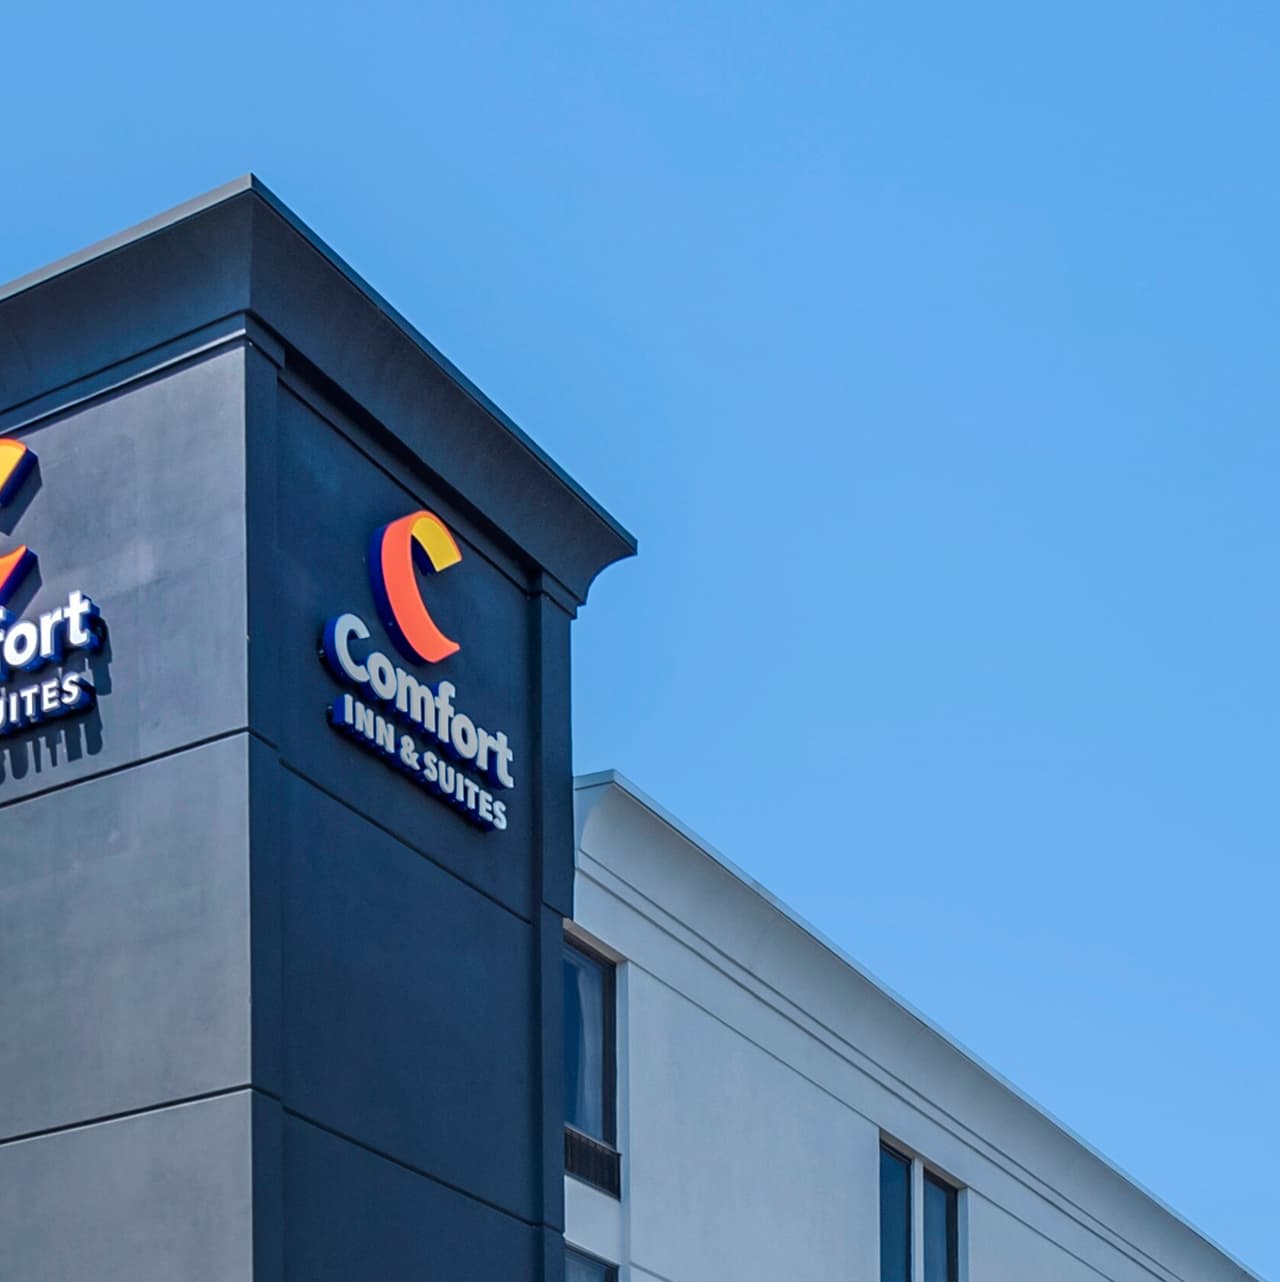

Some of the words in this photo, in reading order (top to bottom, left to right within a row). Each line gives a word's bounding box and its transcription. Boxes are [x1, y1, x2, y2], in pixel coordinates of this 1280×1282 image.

[334, 613, 514, 788] Comfort
[344, 694, 395, 753] INN
[400, 735, 421, 770] &
[423, 751, 507, 830] SUITES
